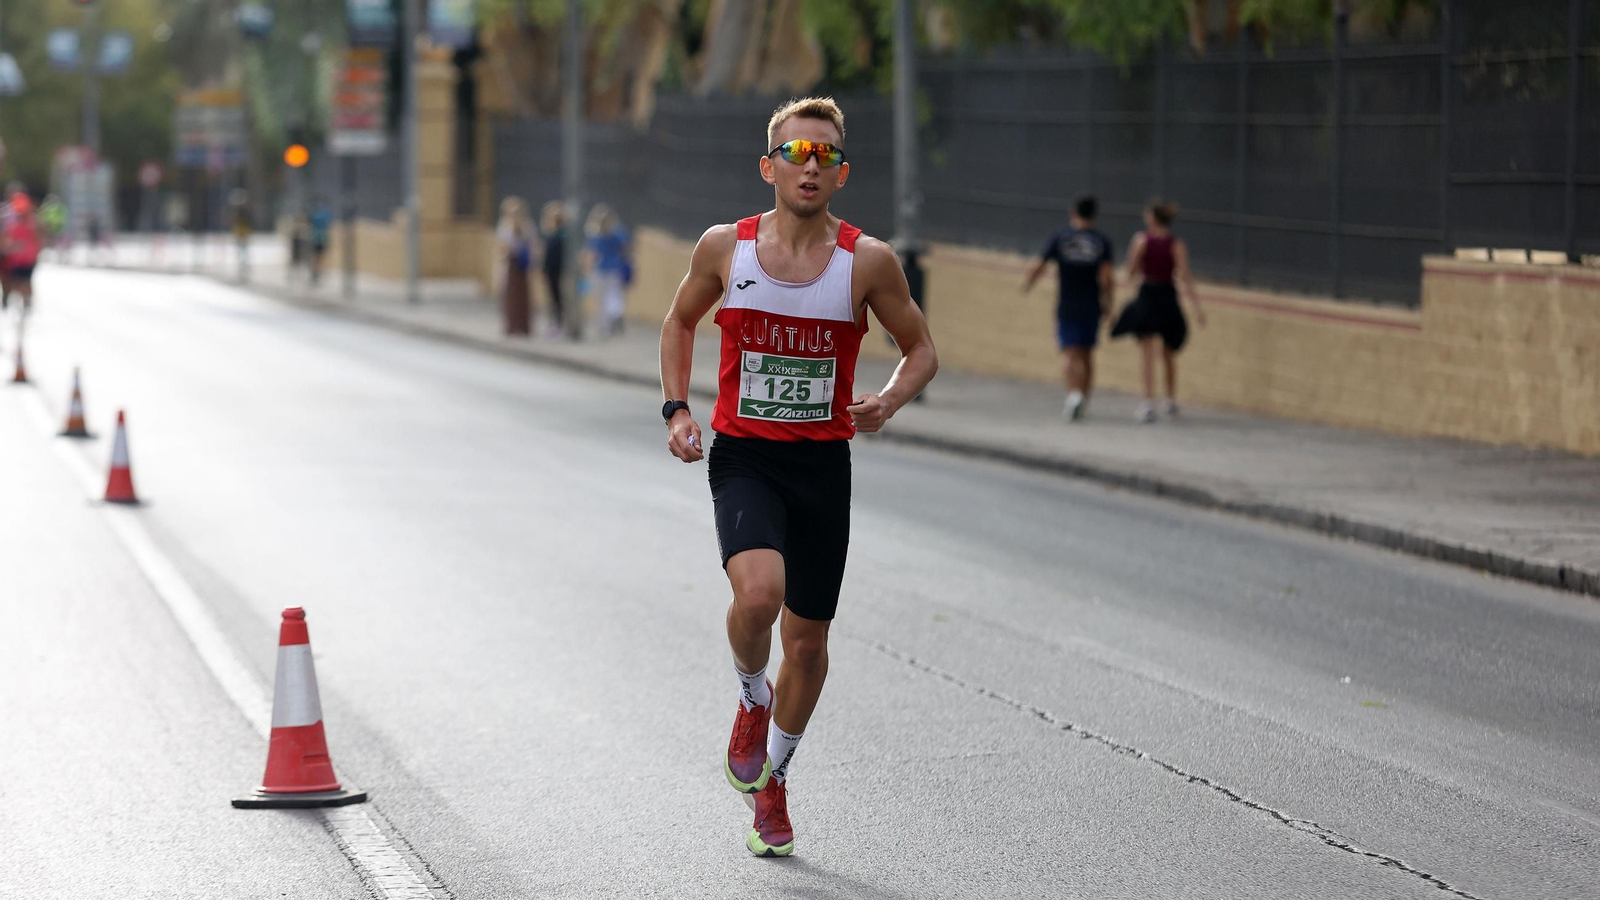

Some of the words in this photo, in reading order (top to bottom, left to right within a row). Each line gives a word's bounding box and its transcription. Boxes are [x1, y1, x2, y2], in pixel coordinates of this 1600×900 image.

[741, 318, 834, 352] CURTIUS
[767, 365, 791, 375] XXIX
[764, 377, 811, 401] 125
[772, 407, 824, 418] MIZUNO
